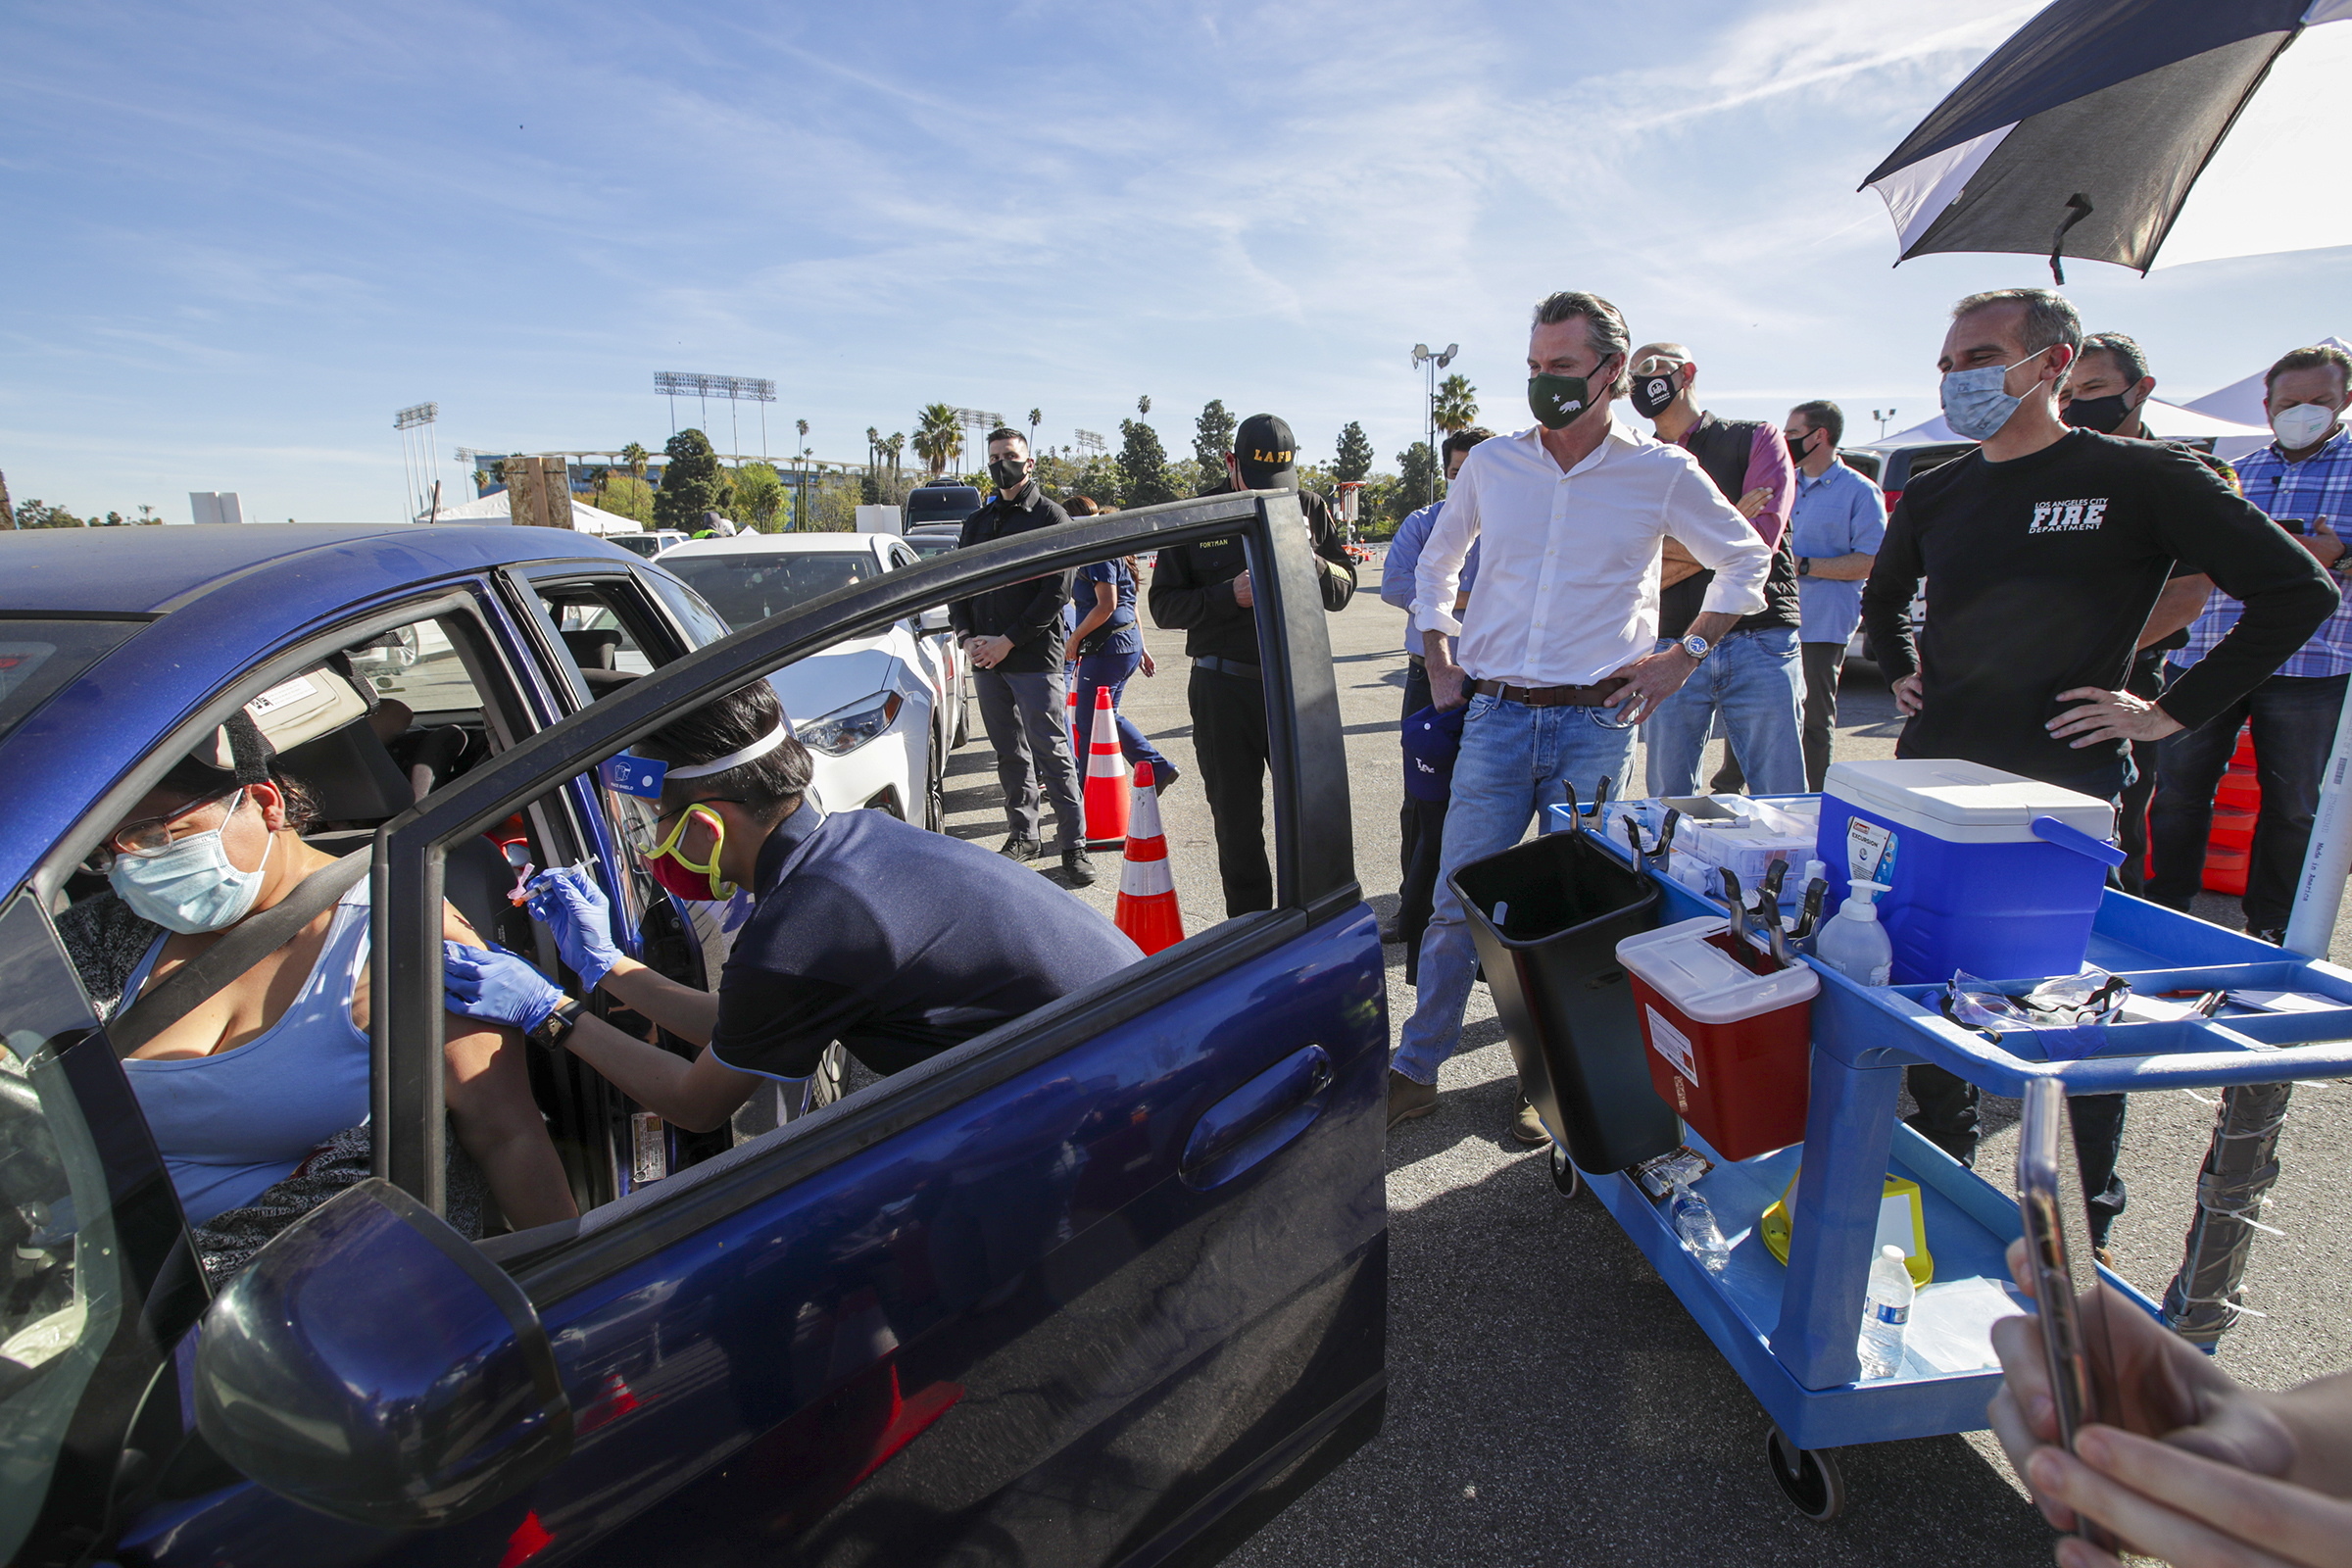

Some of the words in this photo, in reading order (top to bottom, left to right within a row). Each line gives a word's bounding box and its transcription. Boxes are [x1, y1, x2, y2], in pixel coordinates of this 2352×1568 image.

[1253, 449, 1292, 463] LAFD
[2051, 498, 2088, 508] ANGELES
[2089, 497, 2109, 506] CITY
[2030, 504, 2108, 528] FIRE
[2028, 522, 2102, 534] DEPARTMENT
[1200, 539, 1228, 549] FORTMAN
[1415, 757, 1435, 773] LA
[1851, 832, 1879, 848] EXCURSION
[2314, 842, 2325, 858] Made
[2310, 861, 2319, 870] in
[2302, 873, 2316, 902] America
